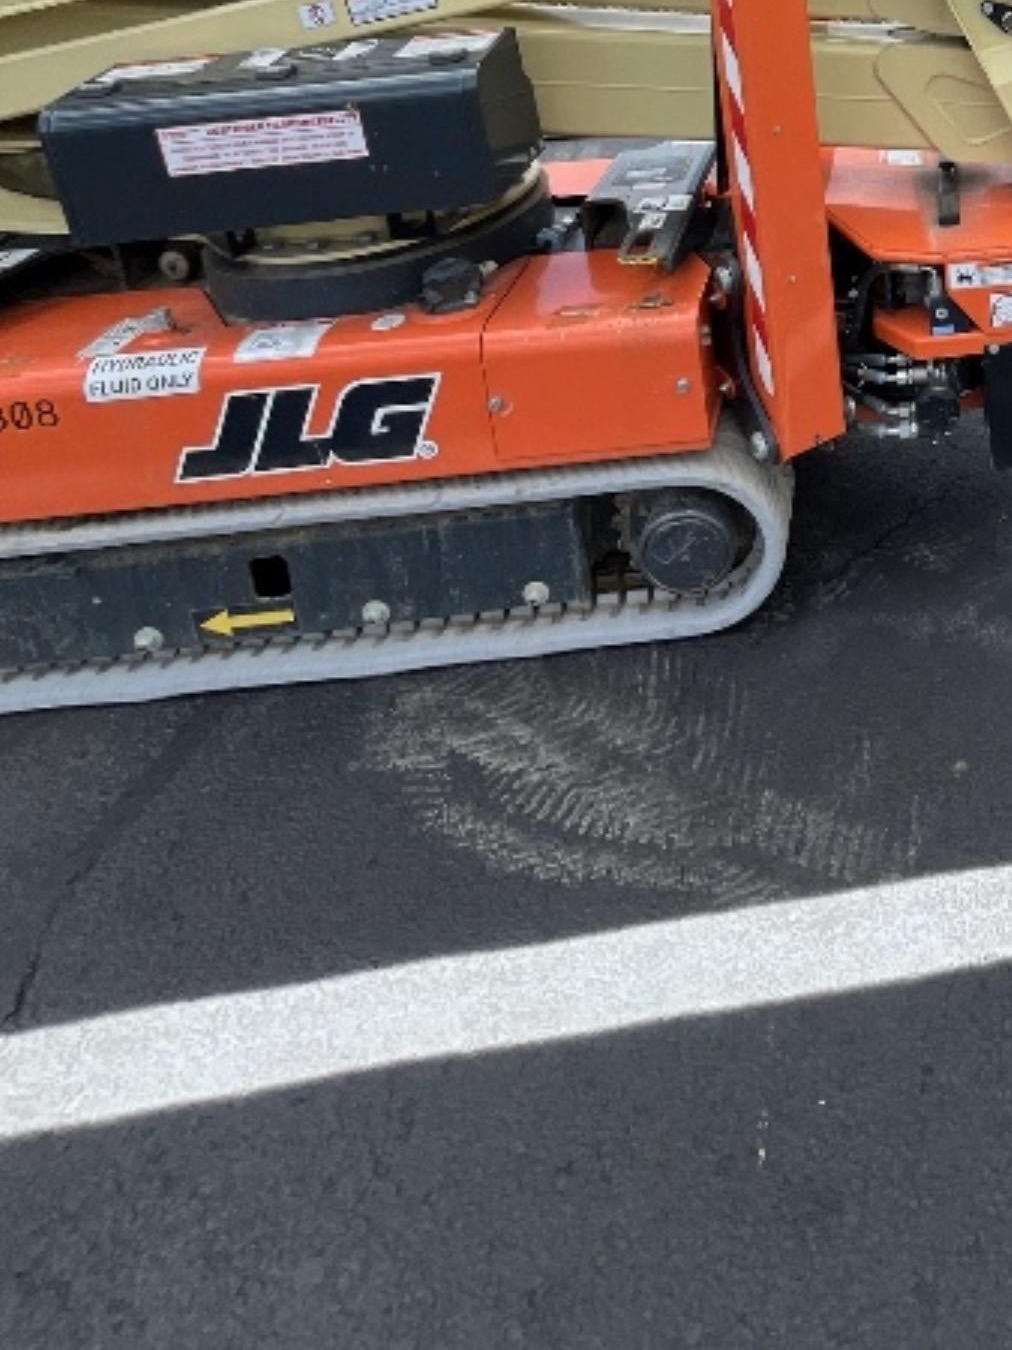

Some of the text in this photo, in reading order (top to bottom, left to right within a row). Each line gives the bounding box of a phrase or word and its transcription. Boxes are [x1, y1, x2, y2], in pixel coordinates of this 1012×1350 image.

[89, 372, 194, 397] FLUID ONLY
[174, 372, 442, 484] JLG
